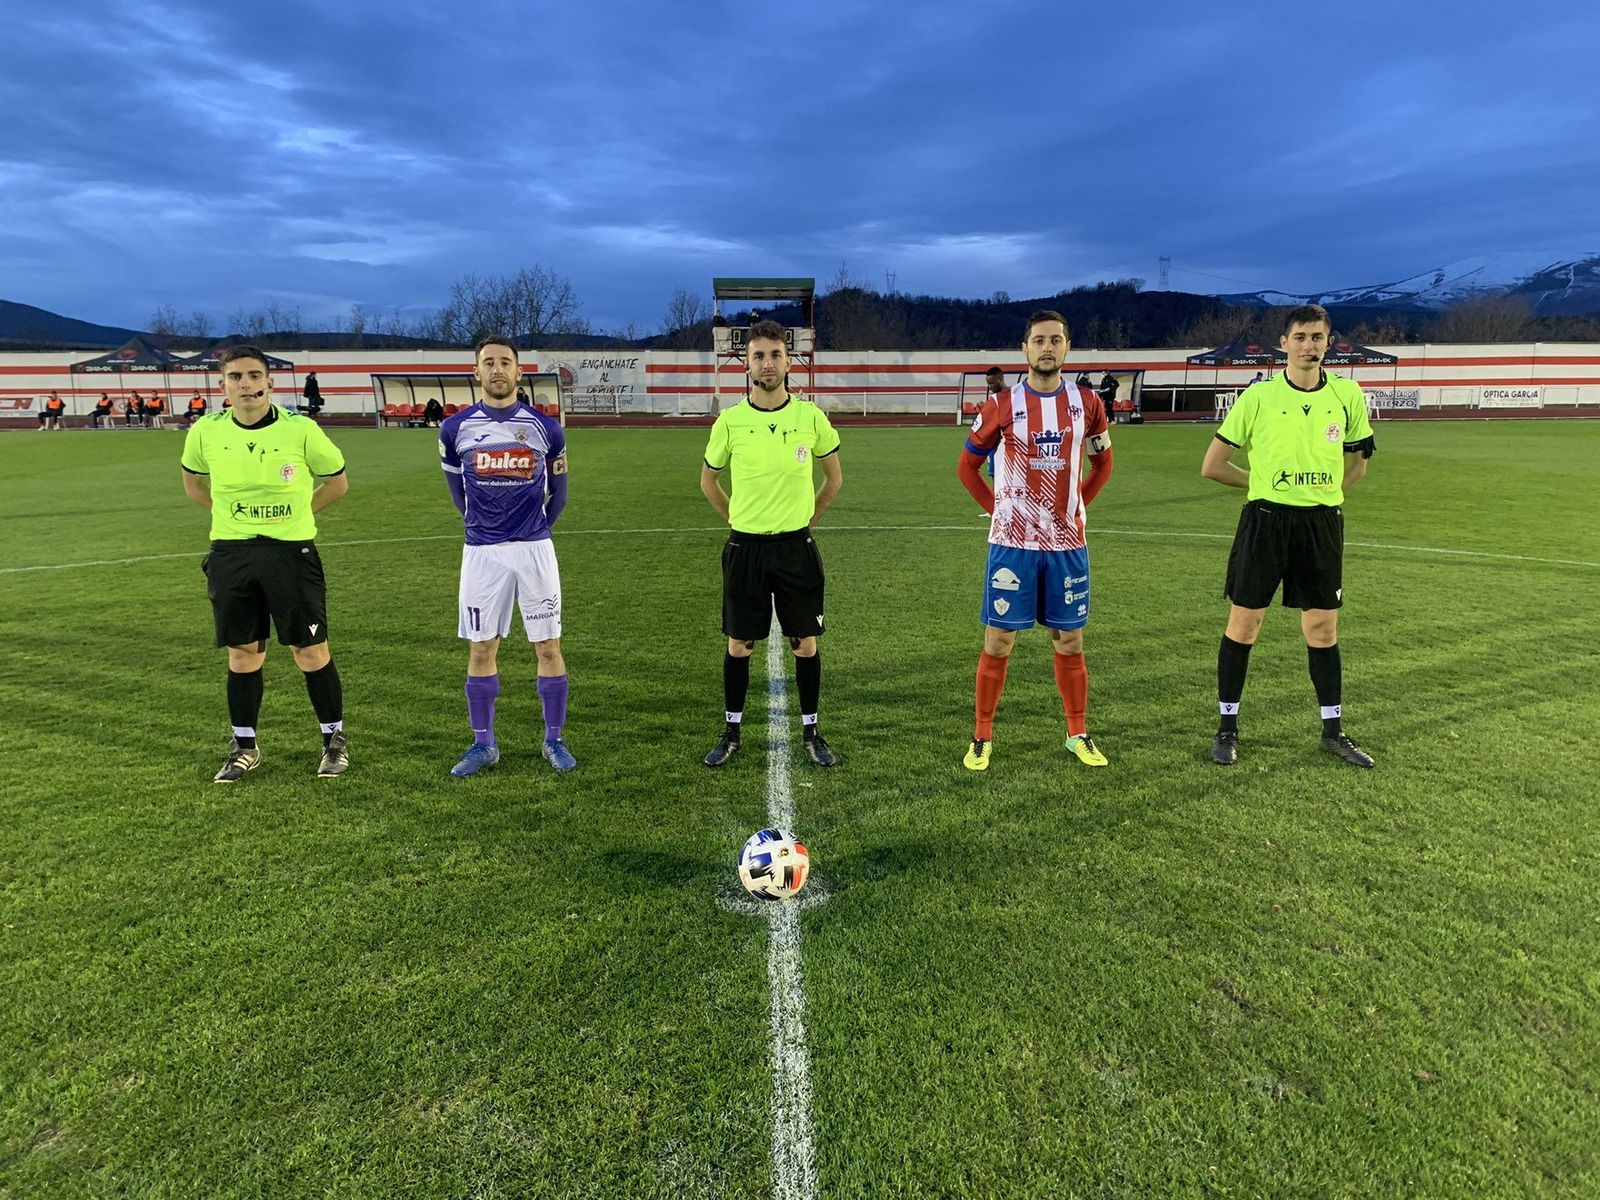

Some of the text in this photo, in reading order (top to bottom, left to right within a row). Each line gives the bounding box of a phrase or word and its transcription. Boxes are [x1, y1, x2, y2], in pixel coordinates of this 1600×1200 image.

[599, 372, 609, 382] AL
[1038, 444, 1060, 457] NB
[1091, 435, 1105, 453] C
[476, 452, 530, 470] Dulca
[553, 458, 565, 476] C
[1295, 471, 1333, 485] INTEGRA
[250, 504, 292, 519] INTEGRA
[467, 606, 480, 632] 11
